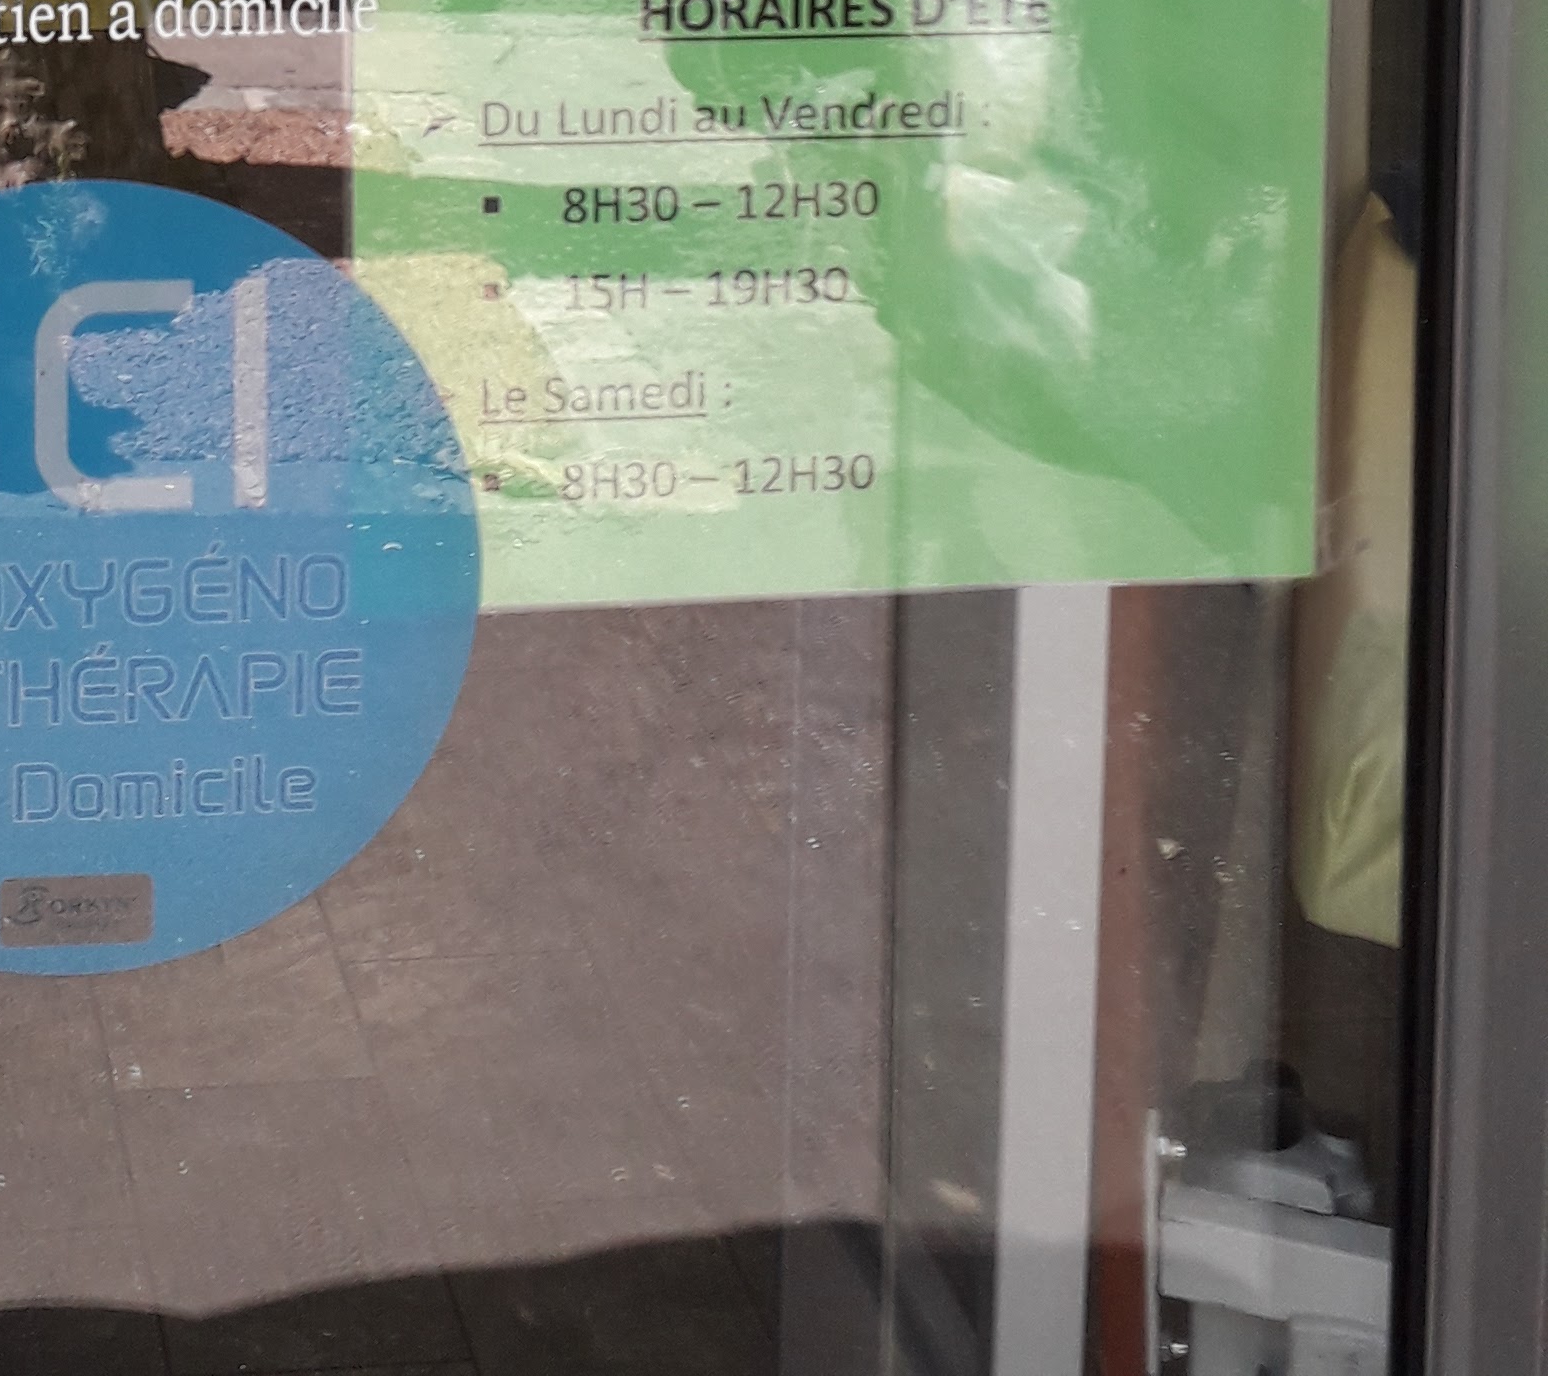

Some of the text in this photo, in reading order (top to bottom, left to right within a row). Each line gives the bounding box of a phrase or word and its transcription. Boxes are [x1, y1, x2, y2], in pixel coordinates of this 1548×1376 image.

[480, 99, 541, 138] Du
[558, 94, 679, 138] Lundi
[693, 104, 749, 134] au
[759, 90, 966, 134] Vendredi
[560, 184, 680, 224] 8H30
[735, 180, 880, 220] 12H30
[564, 275, 649, 311] 15H
[705, 268, 851, 307] 19H30
[481, 379, 527, 415] Le
[542, 369, 707, 415] Samedi
[560, 465, 678, 502] 8H30
[733, 455, 876, 497] 12H30
[13, 755, 318, 823] Domicile
